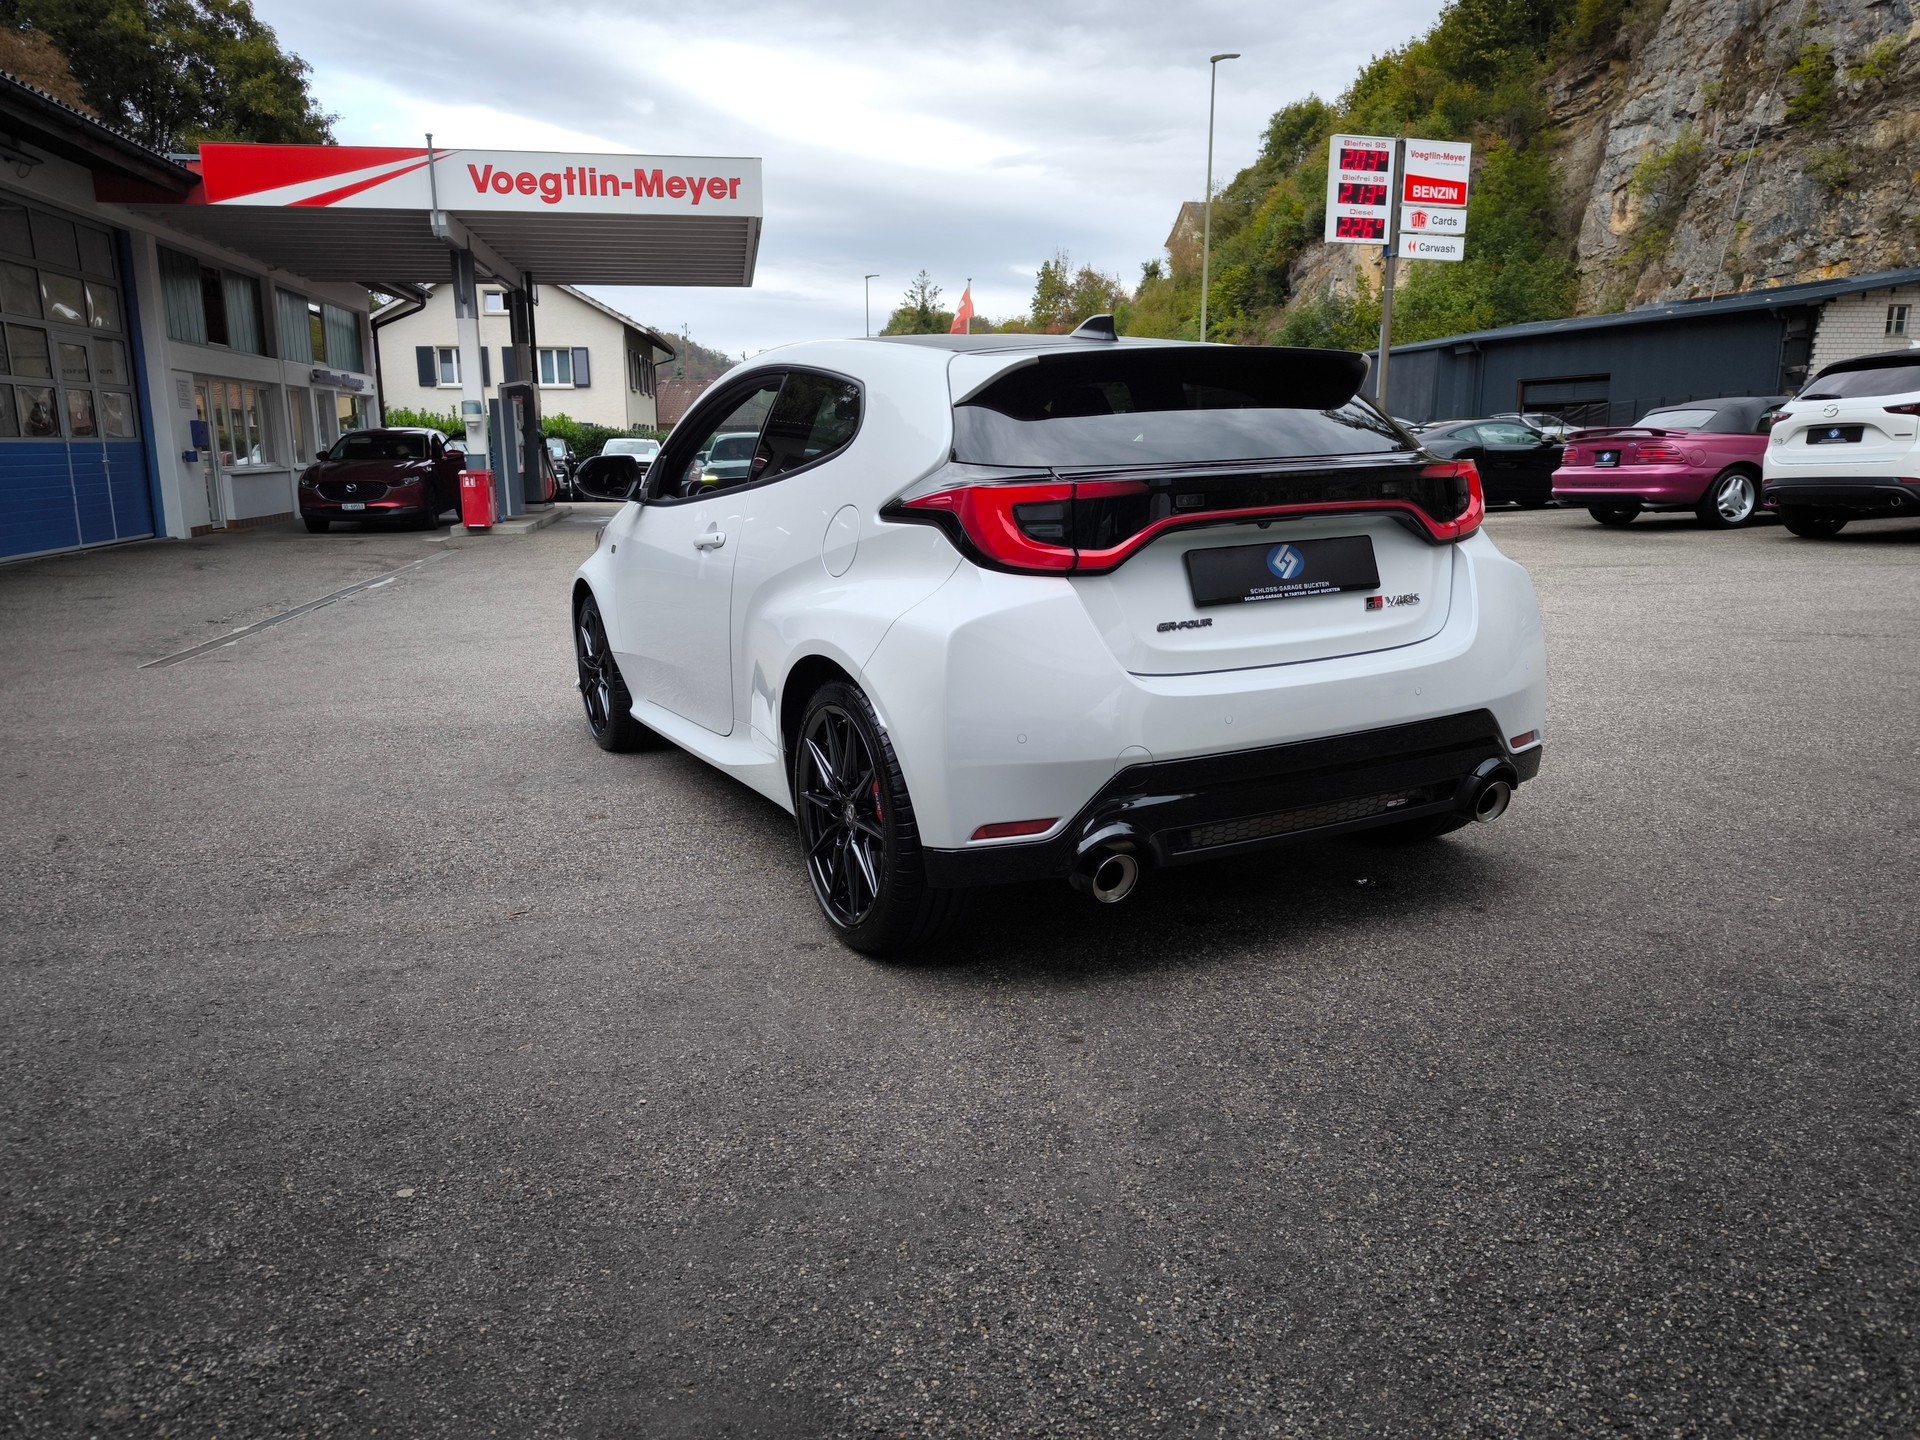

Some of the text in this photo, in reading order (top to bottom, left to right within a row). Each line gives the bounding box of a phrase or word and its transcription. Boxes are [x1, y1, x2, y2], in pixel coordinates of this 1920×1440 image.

[1344, 140, 1372, 148] Bleifrei
[1411, 150, 1466, 162] Voegtlin-Meyer
[467, 164, 741, 204] Voegtlin-Meyer
[1342, 174, 1385, 183] Bleifrei 98
[1412, 185, 1458, 200] BENZIN
[1350, 208, 1374, 216] Diesel
[1432, 215, 1458, 226] Cards
[1419, 243, 1456, 254] Carwash
[1249, 581, 1330, 595] SCHLOSS-GARAGE BUCKTEN
[1244, 592, 1283, 602] SCHLOSS-GARAGE
[1385, 593, 1420, 608] YARIS
[1157, 617, 1213, 632] GR-FOUR
